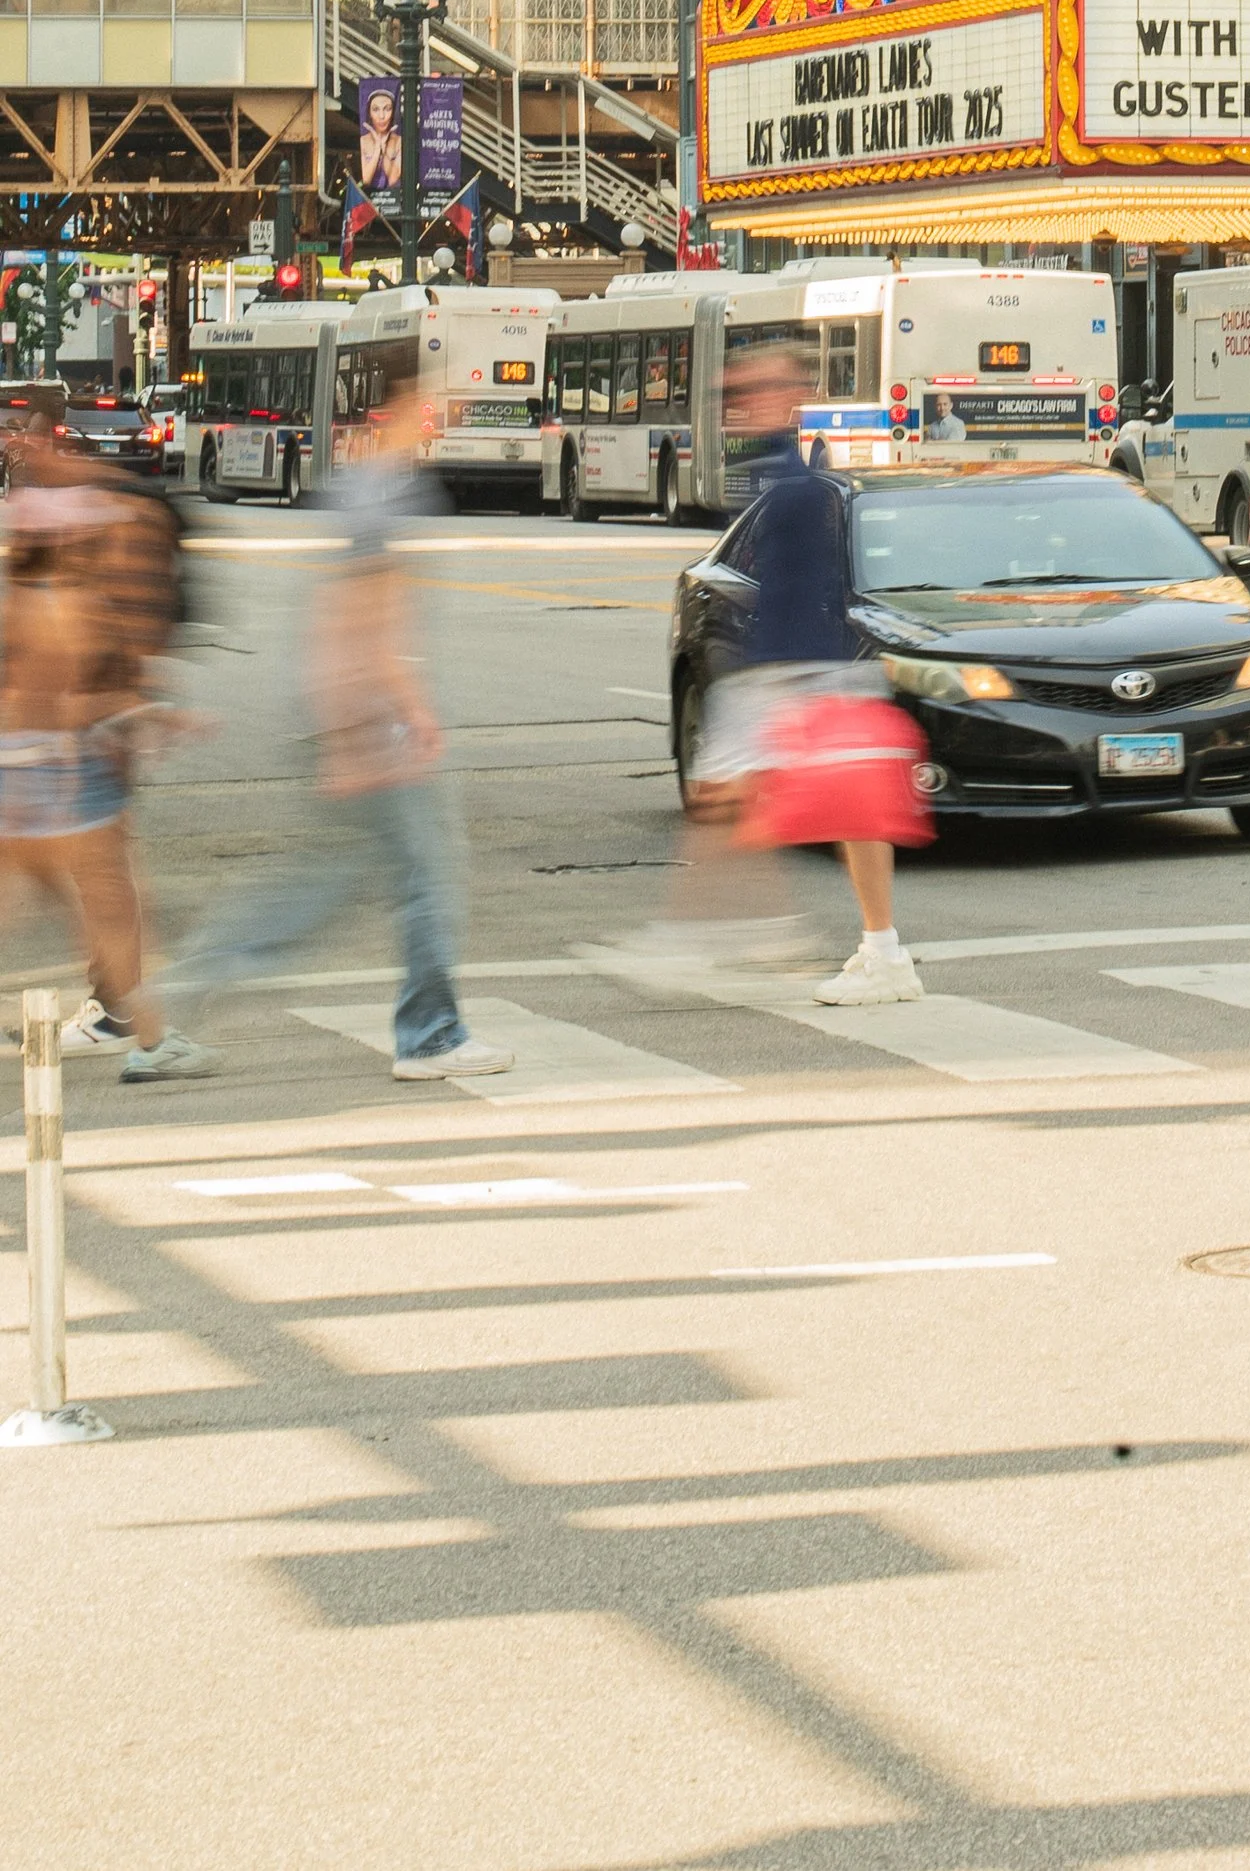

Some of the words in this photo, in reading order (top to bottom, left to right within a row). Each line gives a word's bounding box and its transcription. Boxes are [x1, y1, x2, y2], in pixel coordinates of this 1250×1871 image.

[1137, 20, 1237, 57] WITH
[794, 48, 871, 106] BARENAKED
[878, 37, 933, 94] LADIES
[746, 119, 774, 167] LAST
[780, 111, 830, 162] SUMMER
[836, 107, 854, 157] ON
[861, 99, 908, 153] EARTH
[915, 92, 955, 146] TOUR
[963, 84, 1003, 140] 2025
[253, 223, 271, 231] ONE
[253, 232, 272, 240] WAY
[987, 295, 1020, 307] 4388
[502, 325, 527, 335] 4018
[990, 345, 1019, 365] 146
[501, 363, 527, 381] 146
[462, 404, 512, 415] CHICAGO
[997, 398, 1038, 413] CHICAGO'S
[1038, 398, 1057, 413] LAW
[1057, 398, 1077, 413] FIRM
